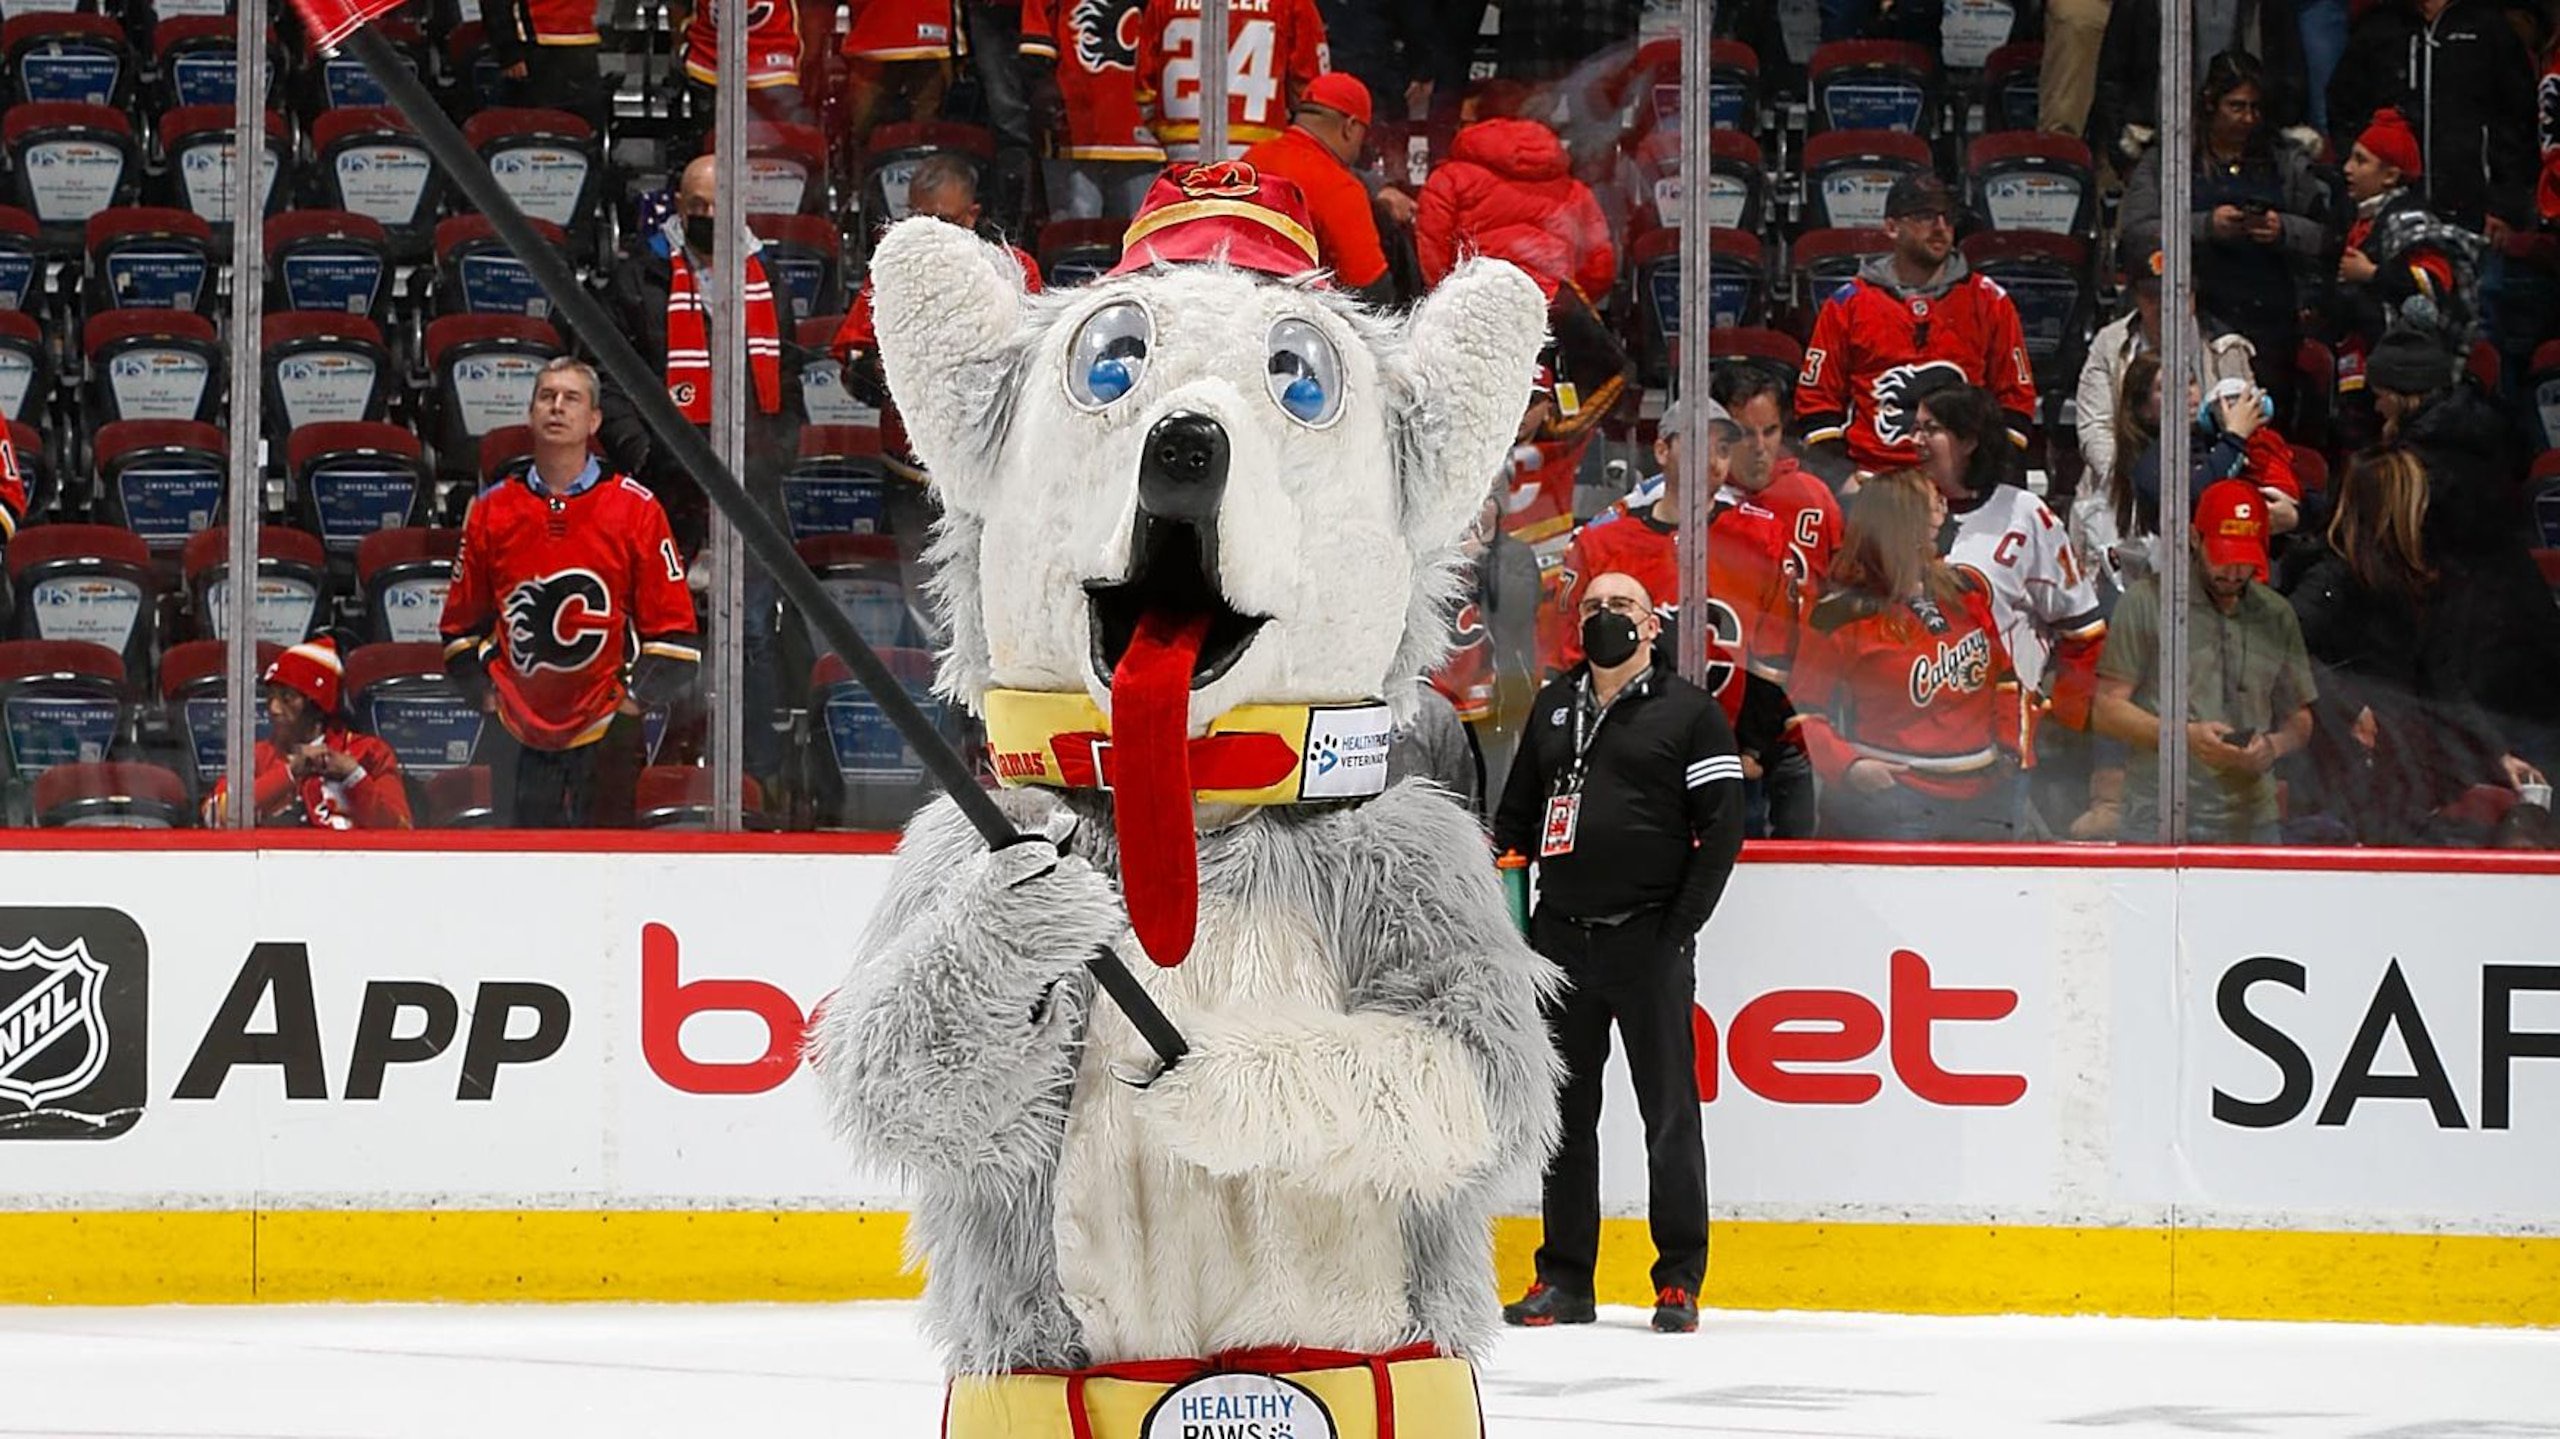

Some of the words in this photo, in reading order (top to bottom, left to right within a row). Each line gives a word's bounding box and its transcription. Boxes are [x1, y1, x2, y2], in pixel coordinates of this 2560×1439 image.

[1175, 0, 1269, 12] HULER
[1163, 18, 1277, 122] 24
[1800, 348, 1826, 387] 3
[1993, 531, 2027, 569] C
[1909, 627, 1989, 707] Calgary
[0, 981, 78, 1067] NHL
[1182, 1394, 1295, 1420] HEALTHY
